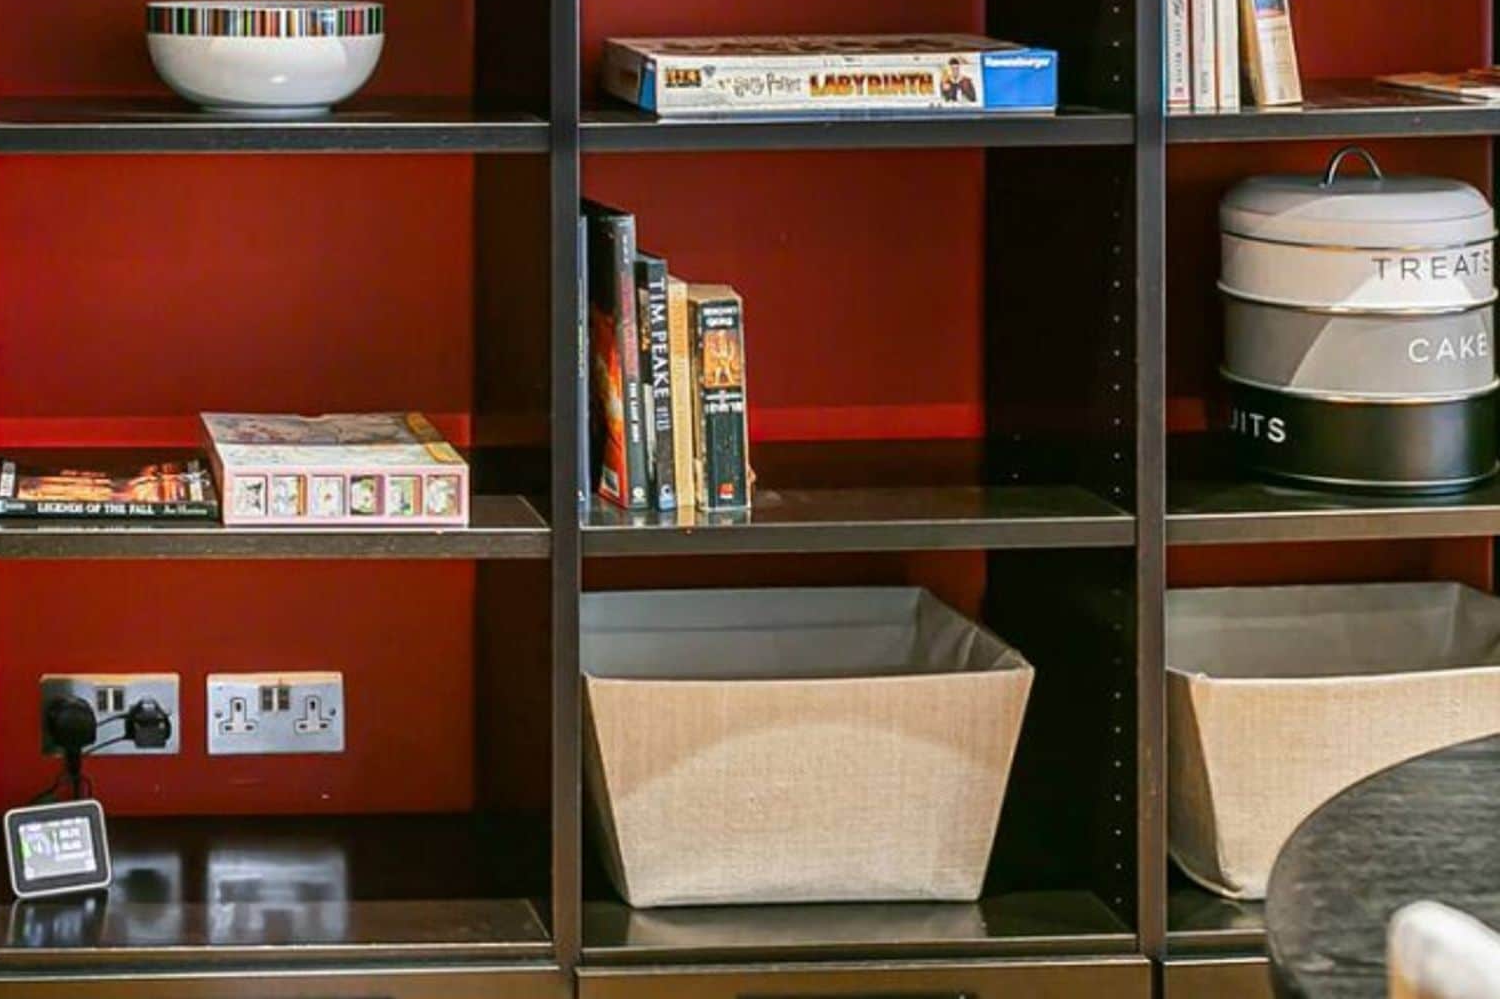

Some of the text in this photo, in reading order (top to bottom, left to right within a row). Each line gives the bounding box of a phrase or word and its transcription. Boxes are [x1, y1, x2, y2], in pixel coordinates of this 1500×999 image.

[809, 73, 934, 96] LABYRINTH
[1371, 251, 1490, 280] TREATS
[648, 276, 666, 324] TIM
[652, 330, 670, 397] PEAKE
[37, 501, 83, 513] LEGENDS
[87, 502, 101, 513] OF
[104, 502, 126, 514] THE
[129, 502, 155, 514] FALL
